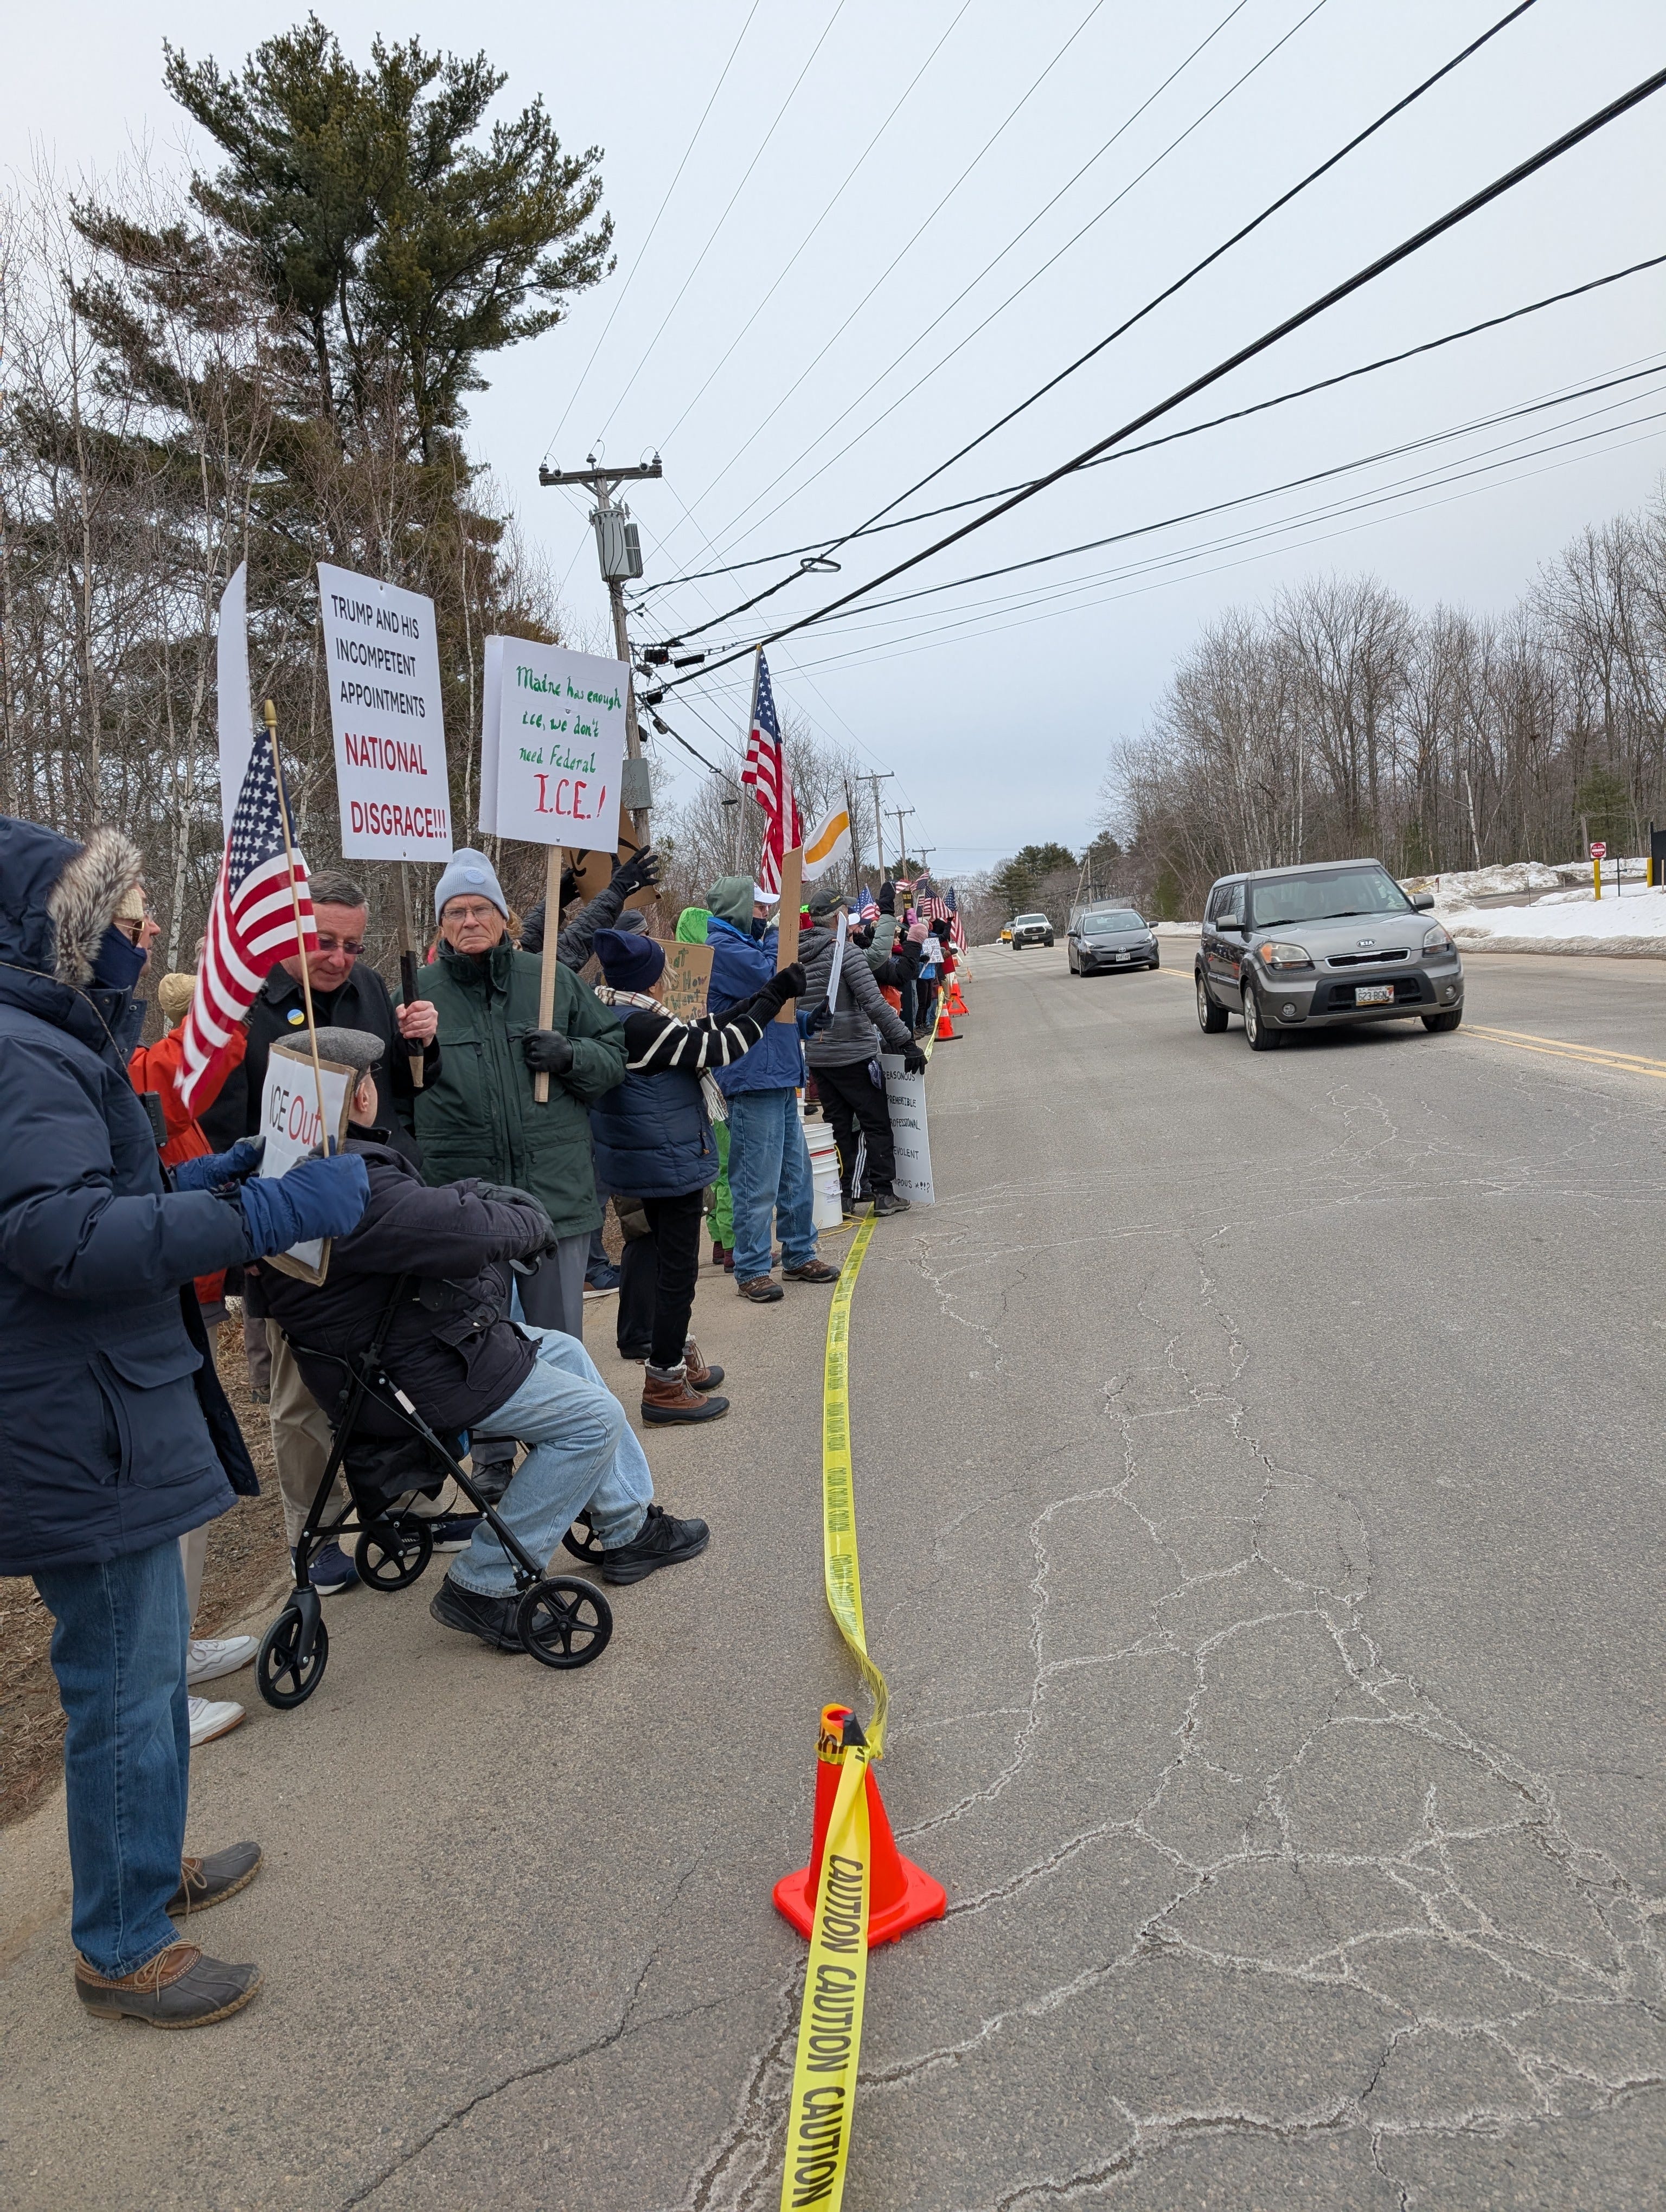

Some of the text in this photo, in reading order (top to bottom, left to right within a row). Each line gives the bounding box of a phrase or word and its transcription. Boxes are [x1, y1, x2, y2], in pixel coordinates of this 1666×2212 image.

[331, 594, 419, 639] TRUMP AND HIS
[336, 638, 415, 677] INCOMPETENT
[341, 680, 425, 718] APPOINTMENTS
[516, 666, 621, 711] Maine has enough
[522, 711, 599, 737] ice, we don't
[345, 733, 427, 775] NATIONAL
[519, 744, 595, 773] need Federal
[351, 801, 446, 838] DISGRACE!!!
[882, 1070, 915, 1082] REASONOUS
[270, 1084, 322, 1148] ICE Out
[889, 1117, 921, 1130] ROFESSIONAL
[893, 1146, 919, 1160] EVOLENT
[791, 1854, 864, 2208] CAUTION CAUTION CAUTION
